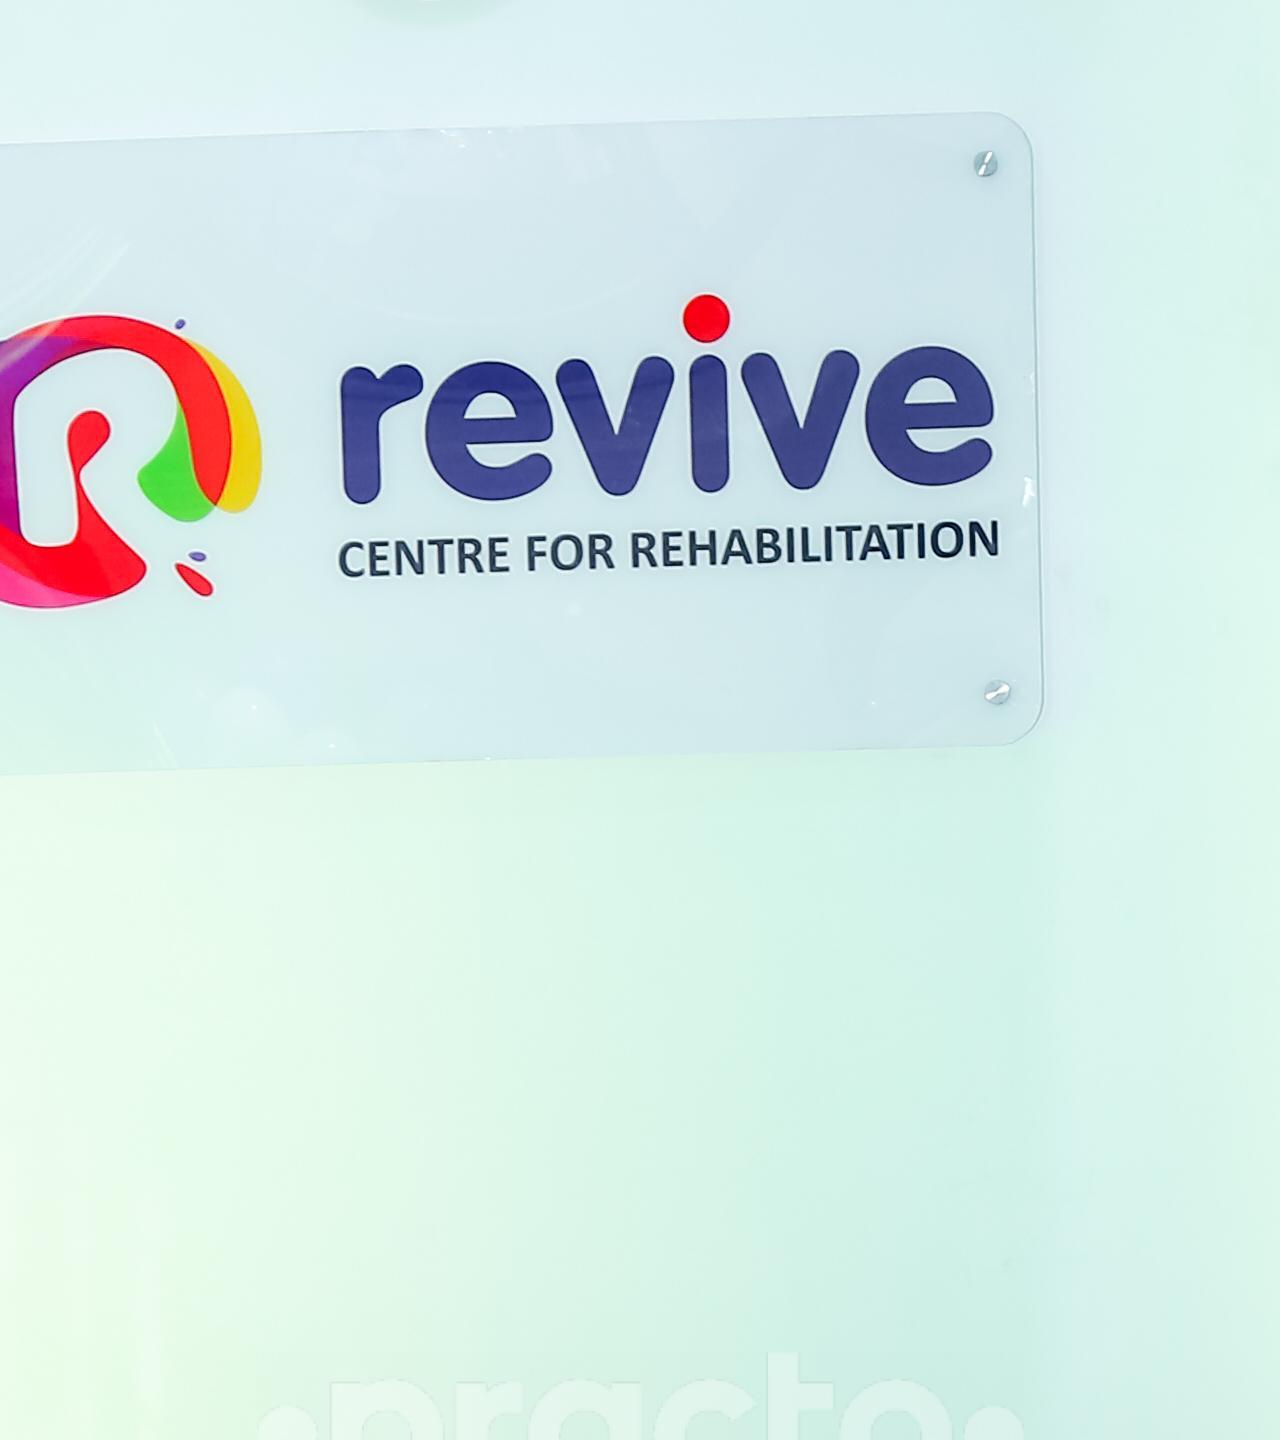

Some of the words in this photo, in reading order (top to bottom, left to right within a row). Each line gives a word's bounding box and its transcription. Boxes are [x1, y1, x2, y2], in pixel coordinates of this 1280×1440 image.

[339, 294, 995, 505] revive
[338, 536, 510, 578] CENTRE
[527, 533, 616, 572] FOR
[631, 519, 999, 569] REHABILITATION
